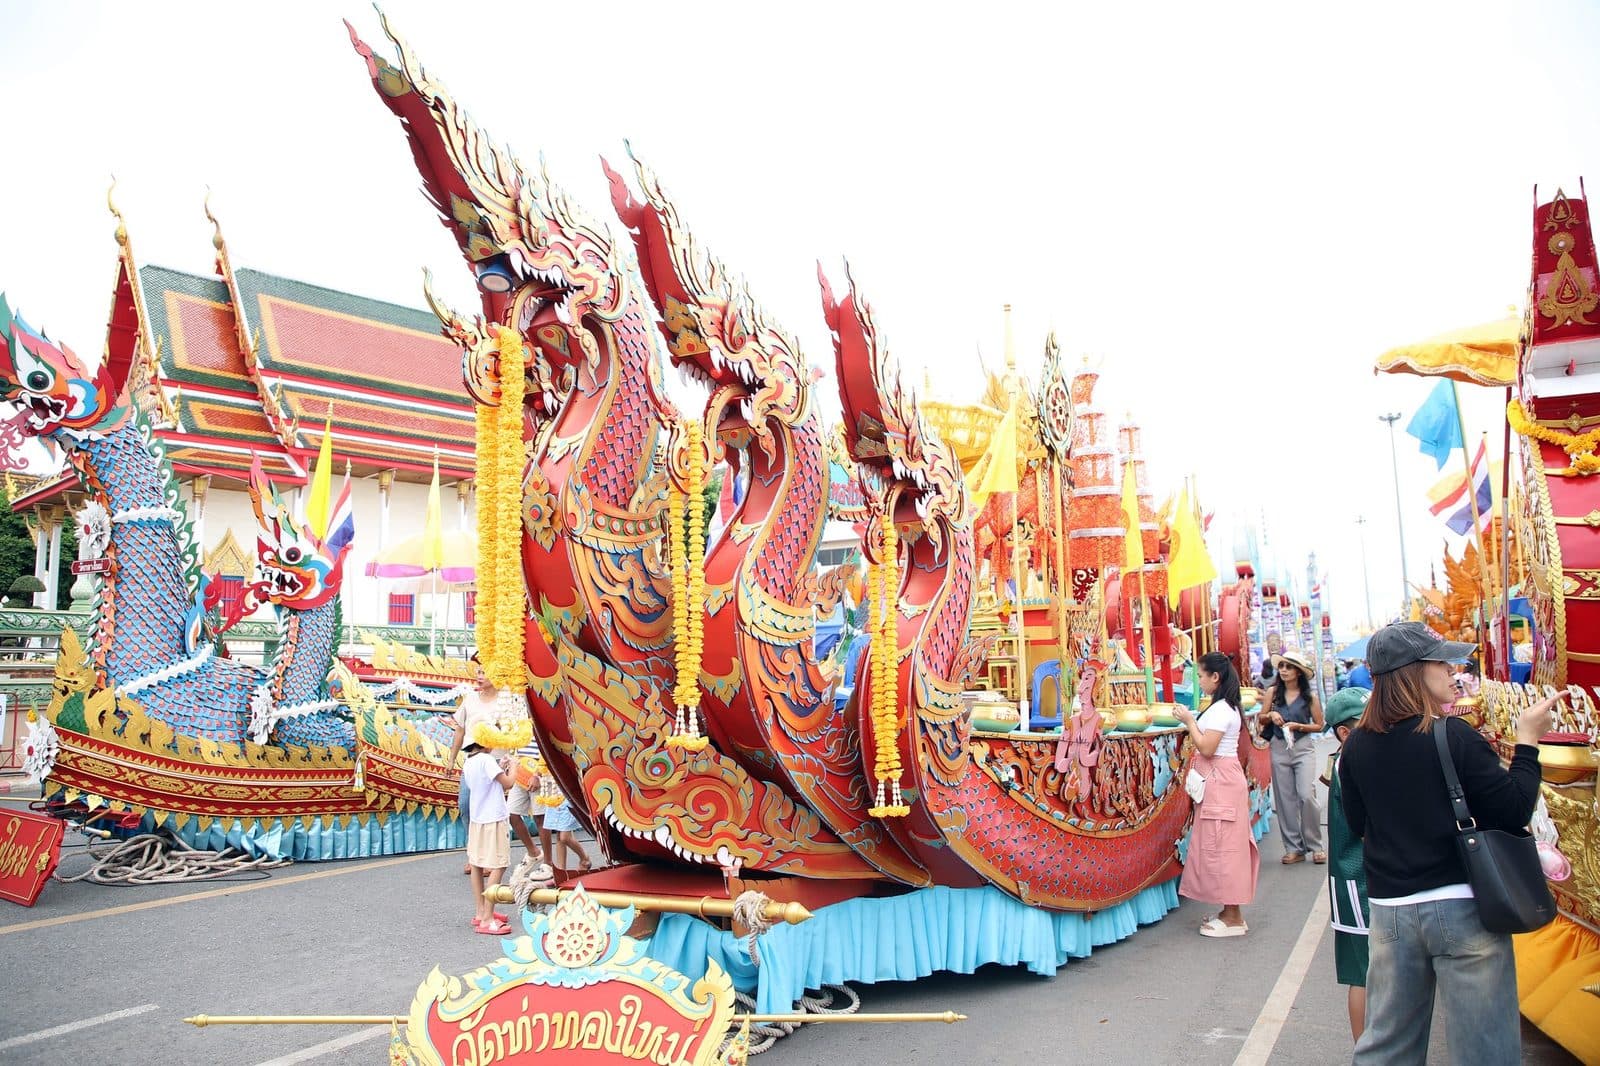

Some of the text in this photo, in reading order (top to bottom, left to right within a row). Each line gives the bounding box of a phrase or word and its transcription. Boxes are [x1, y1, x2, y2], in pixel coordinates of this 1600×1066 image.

[452, 994, 708, 1066] วัดท่าทองใหม่
